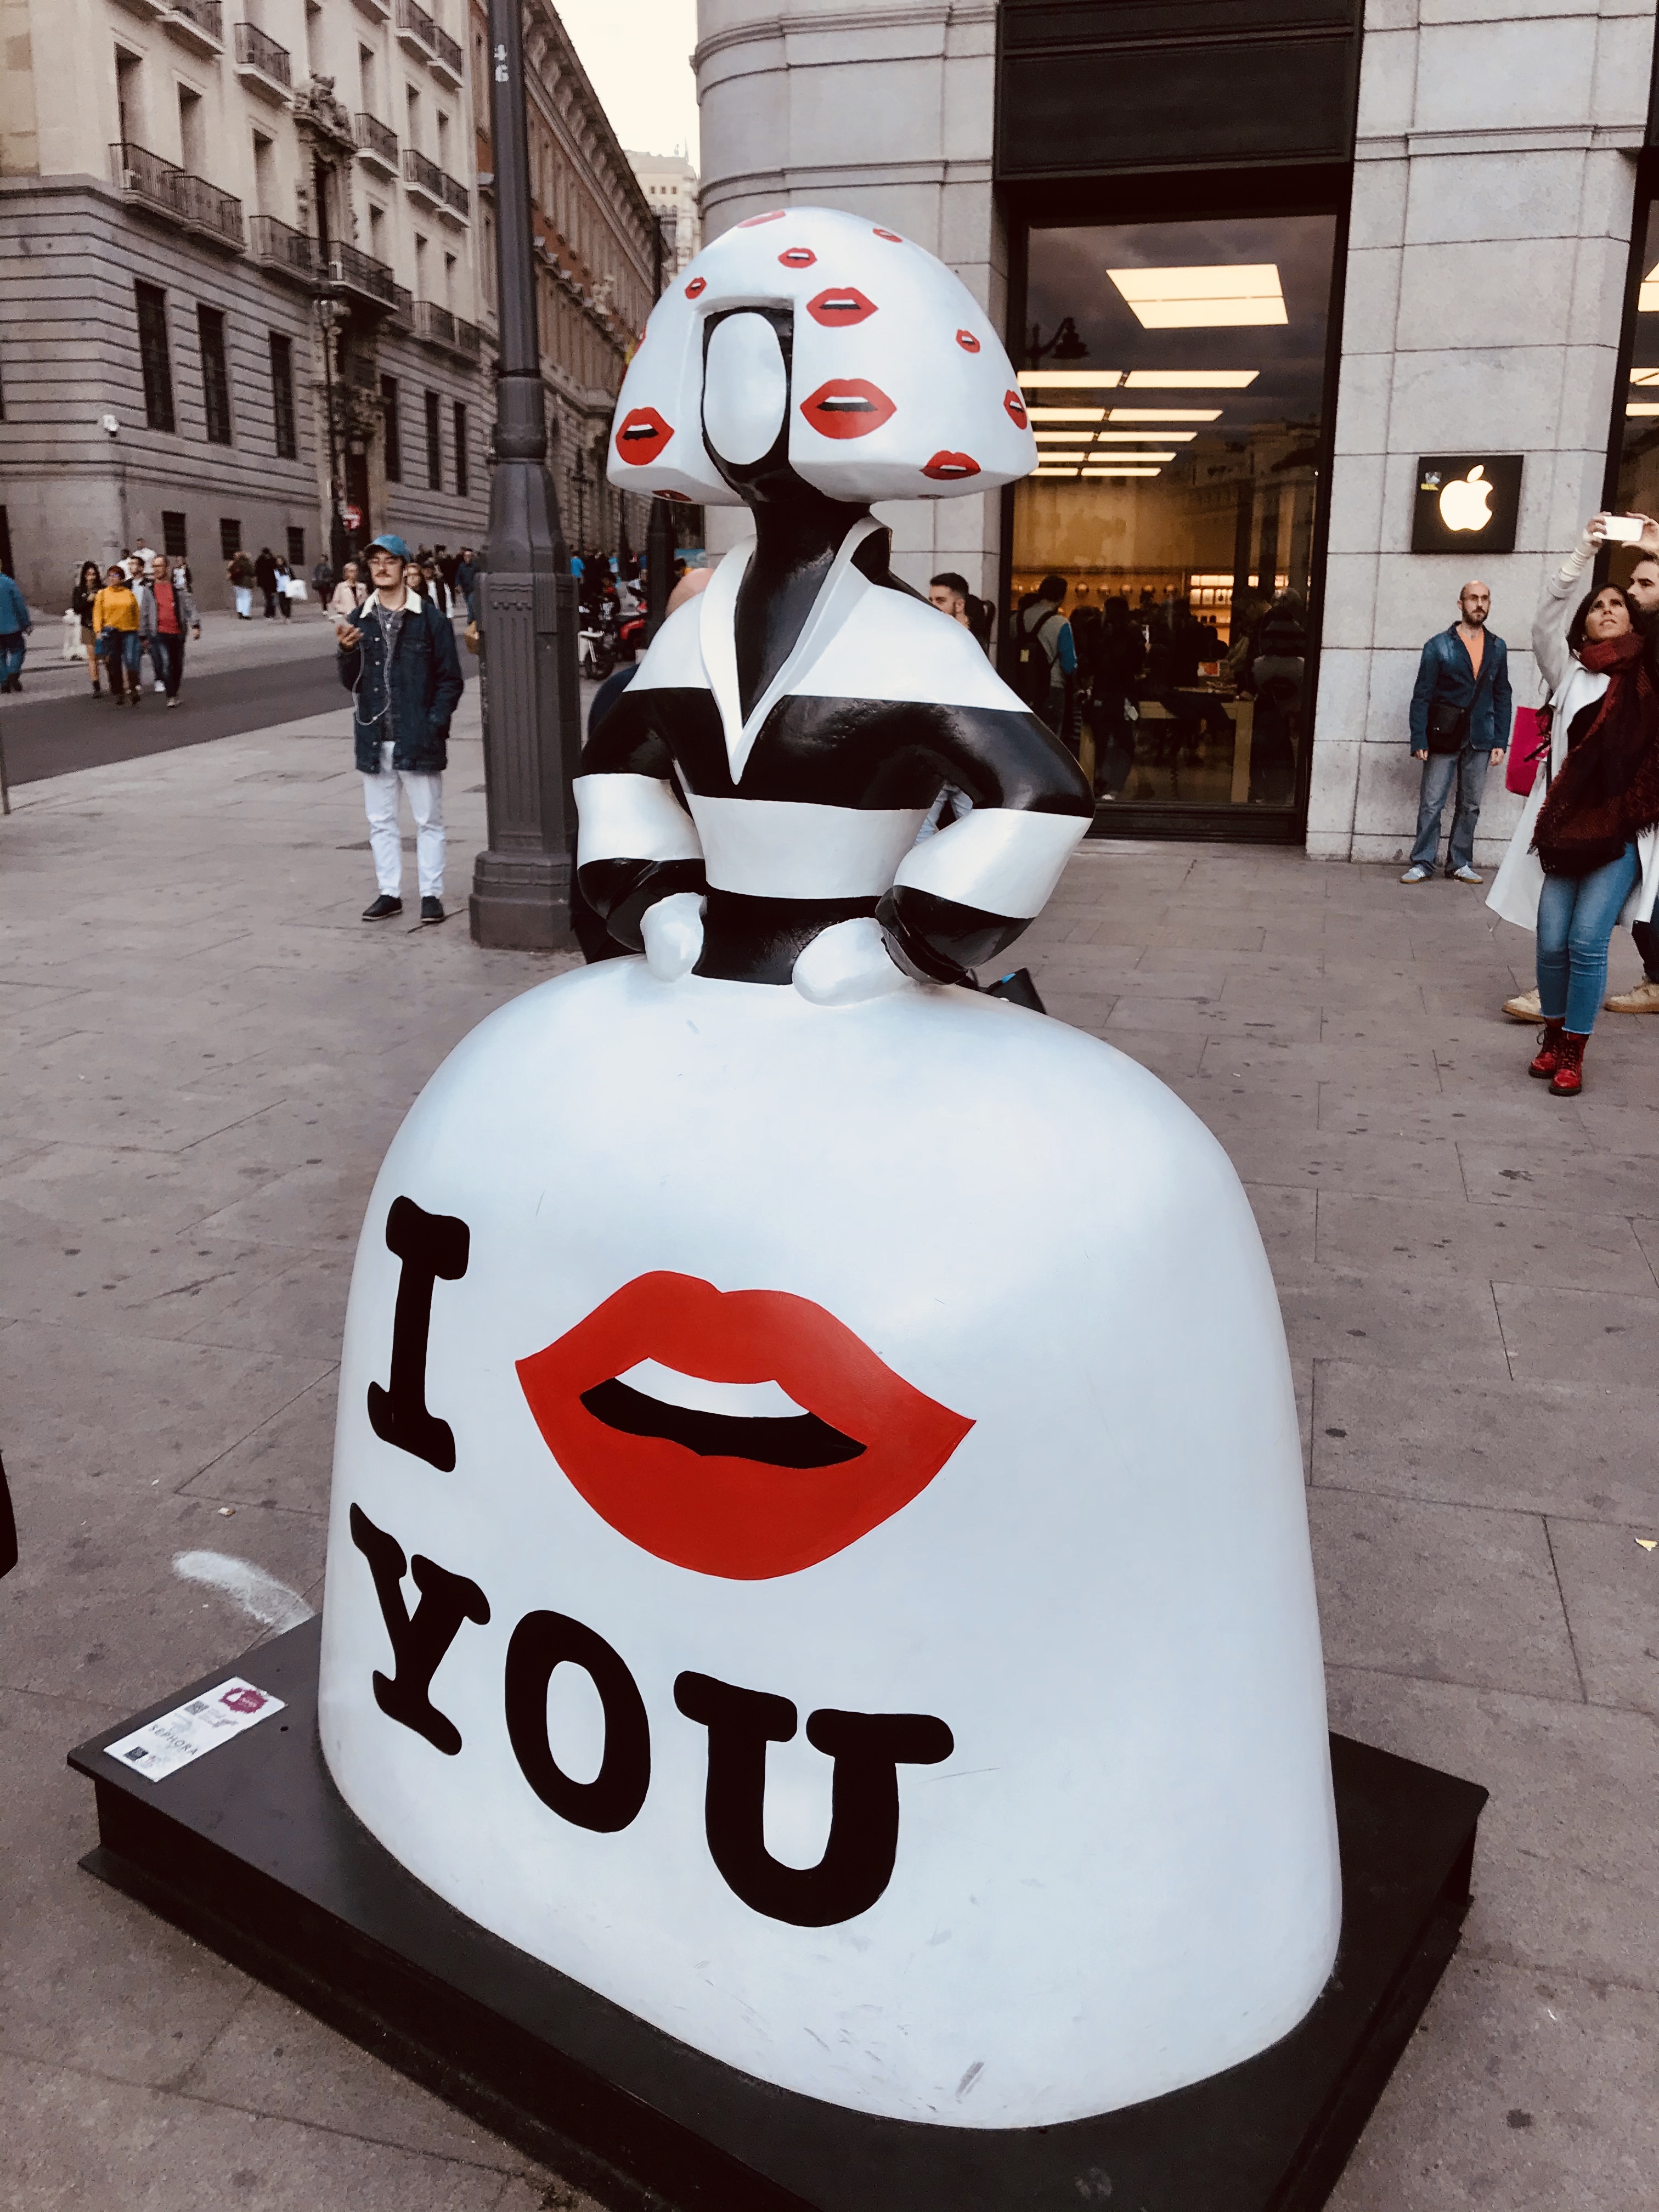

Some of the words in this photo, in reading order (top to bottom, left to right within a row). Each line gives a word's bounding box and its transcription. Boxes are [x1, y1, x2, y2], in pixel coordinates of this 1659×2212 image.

[368, 1195, 470, 1472] I
[149, 1724, 199, 1756] SEPHORA
[350, 1503, 955, 1928] YOU
